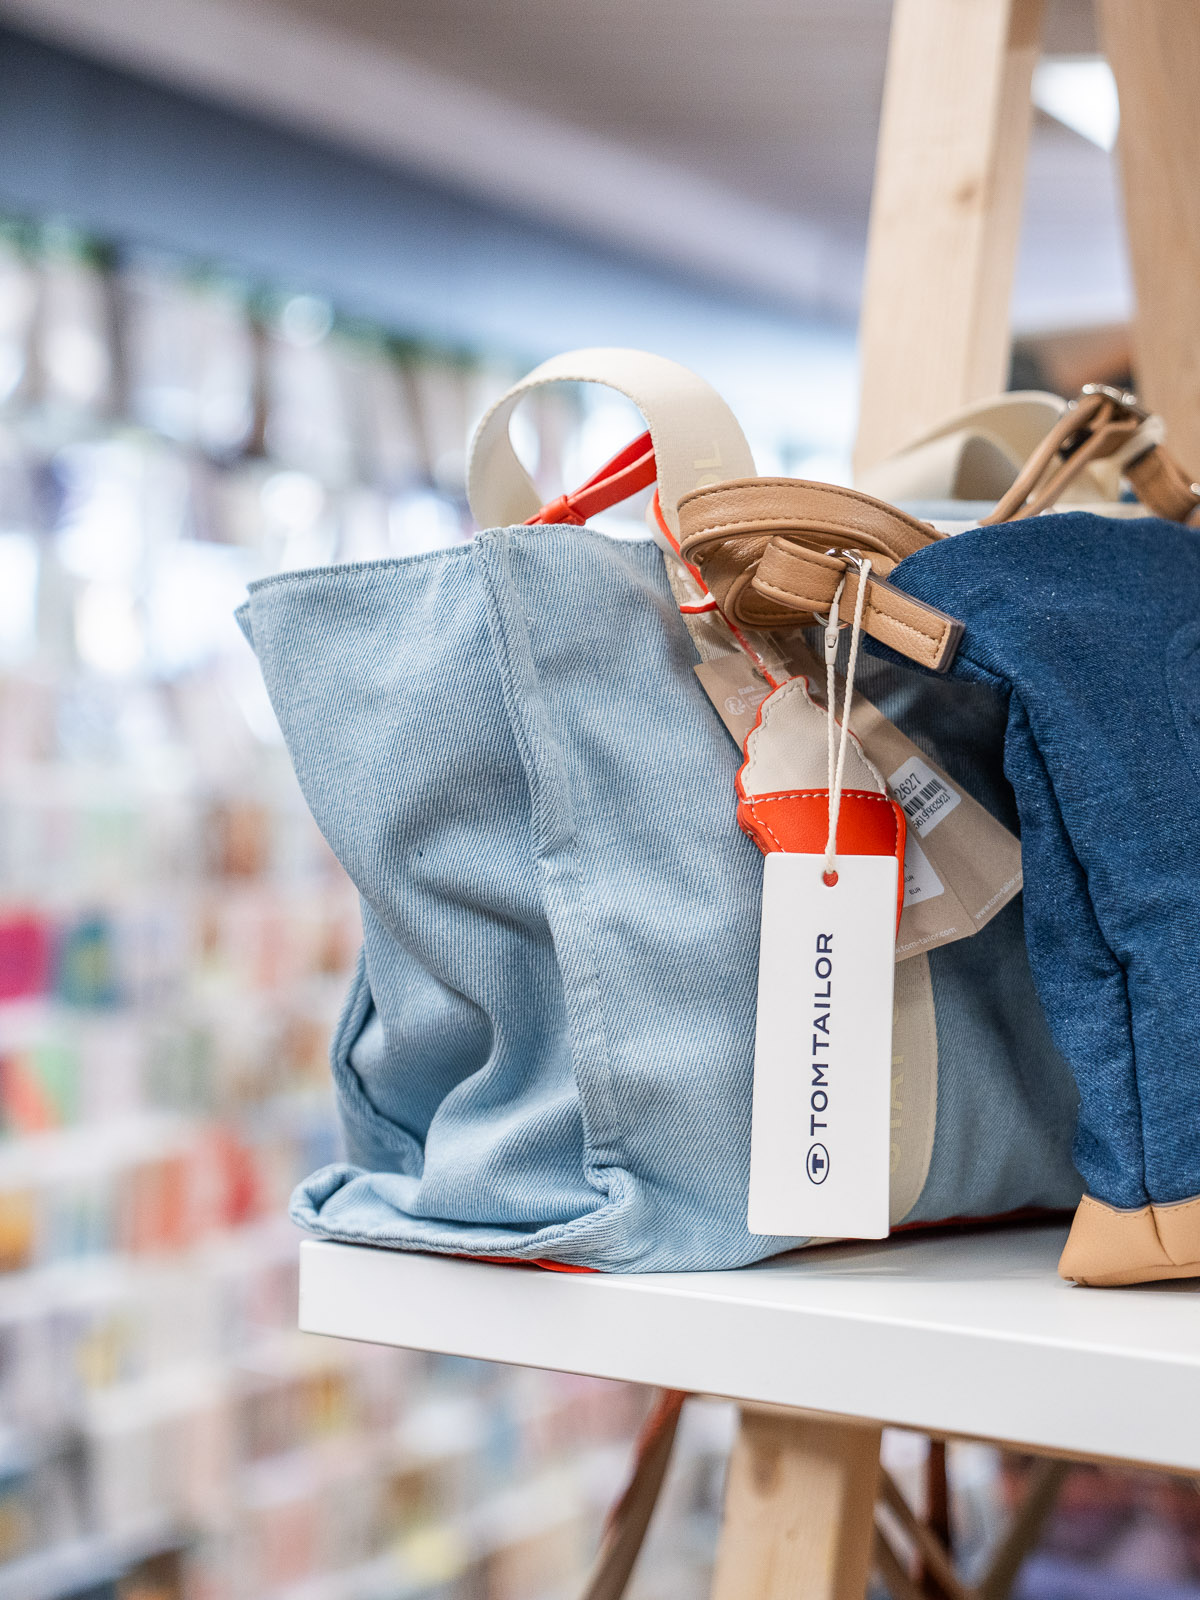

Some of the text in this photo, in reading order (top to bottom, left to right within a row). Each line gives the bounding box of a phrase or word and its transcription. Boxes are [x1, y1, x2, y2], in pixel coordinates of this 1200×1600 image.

[909, 887, 921, 895] EUR
[809, 933, 834, 1136] TOM TAILOR
